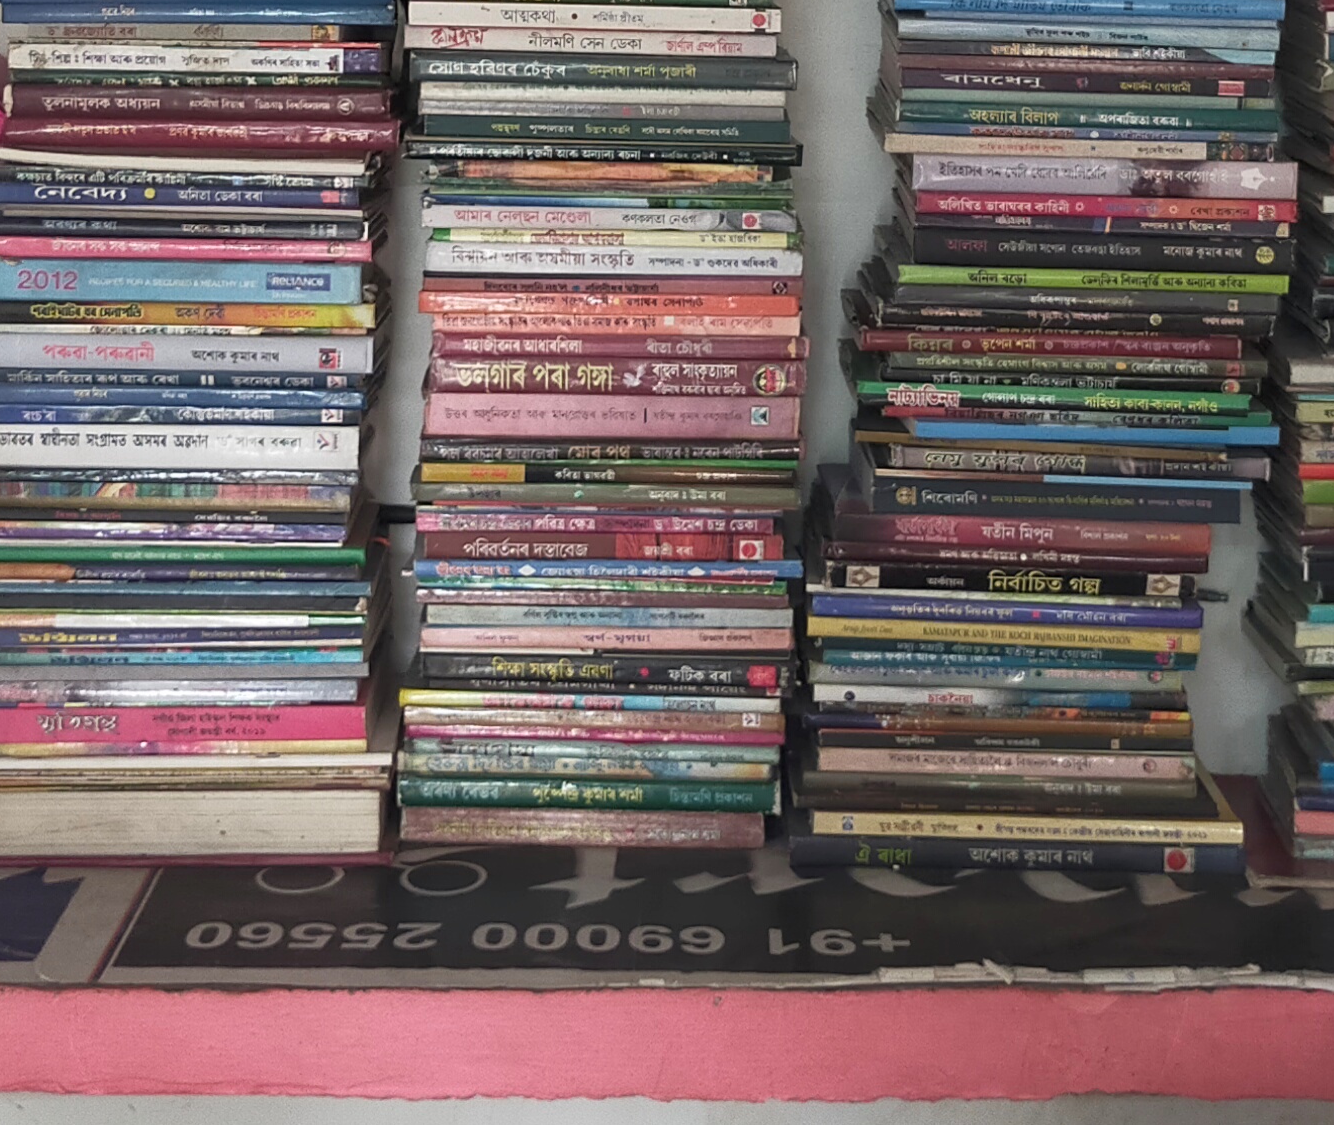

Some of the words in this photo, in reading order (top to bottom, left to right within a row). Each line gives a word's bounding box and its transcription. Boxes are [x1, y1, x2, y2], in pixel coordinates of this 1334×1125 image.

[18, 270, 78, 289] 2012
[991, 630, 1007, 641] THE
[186, 922, 438, 950] 25560
[472, 923, 726, 954] 69000
[768, 926, 912, 956] +91
